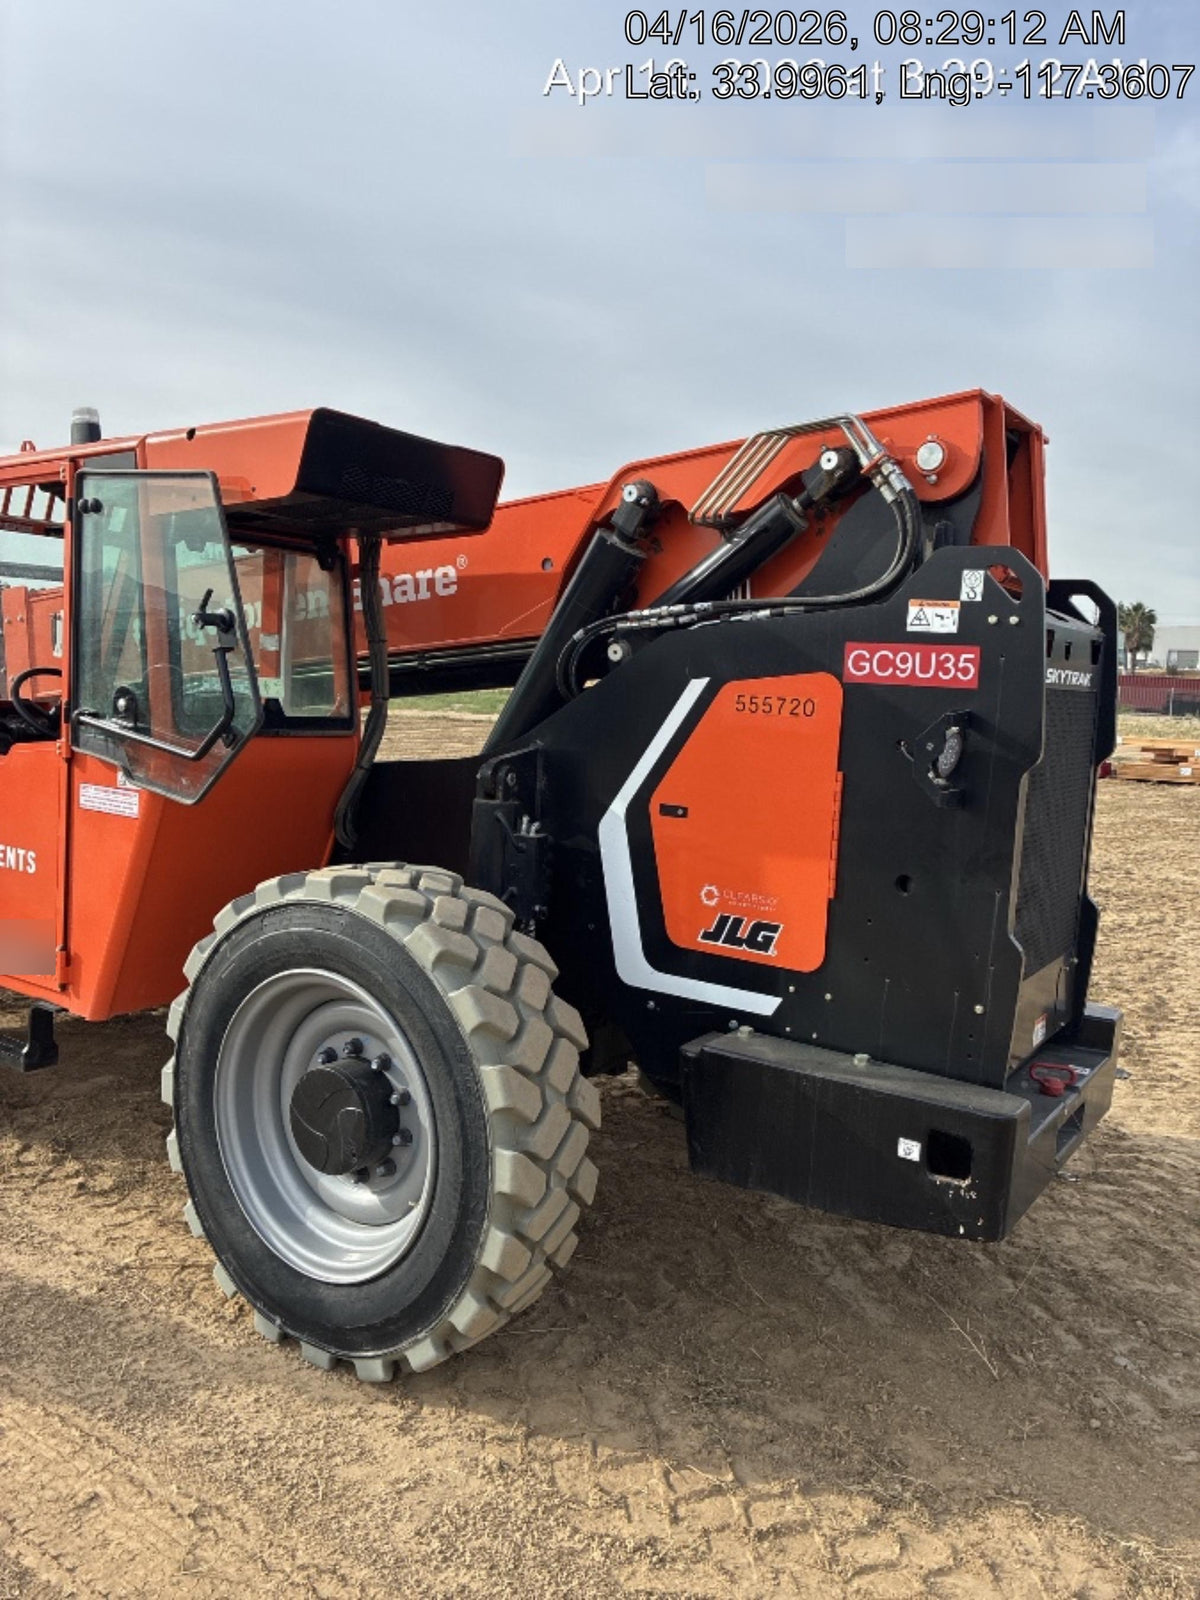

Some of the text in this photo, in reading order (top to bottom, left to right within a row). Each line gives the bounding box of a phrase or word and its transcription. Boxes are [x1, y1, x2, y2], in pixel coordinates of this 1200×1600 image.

[847, 649, 976, 681] GC9U35
[734, 694, 816, 717] 555720
[697, 912, 784, 956] JLG
